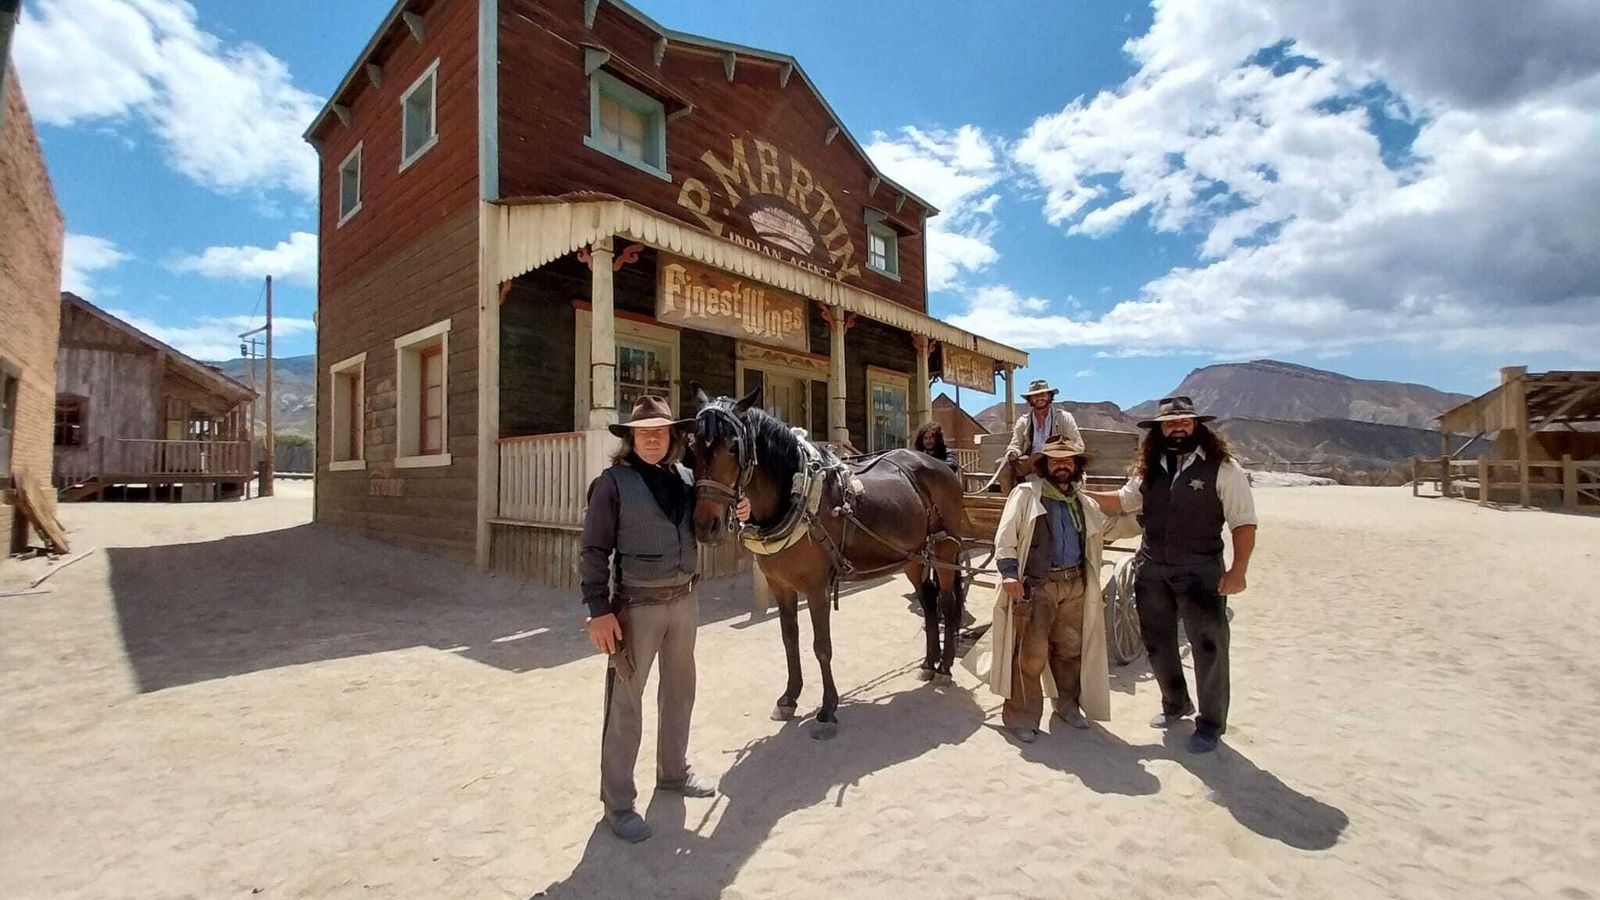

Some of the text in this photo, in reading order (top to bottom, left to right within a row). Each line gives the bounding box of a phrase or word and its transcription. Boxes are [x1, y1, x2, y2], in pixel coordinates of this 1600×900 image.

[700, 137, 862, 281] MARTIN
[728, 231, 832, 277] INDIAN AGENT
[663, 263, 804, 341] Finest Wines
